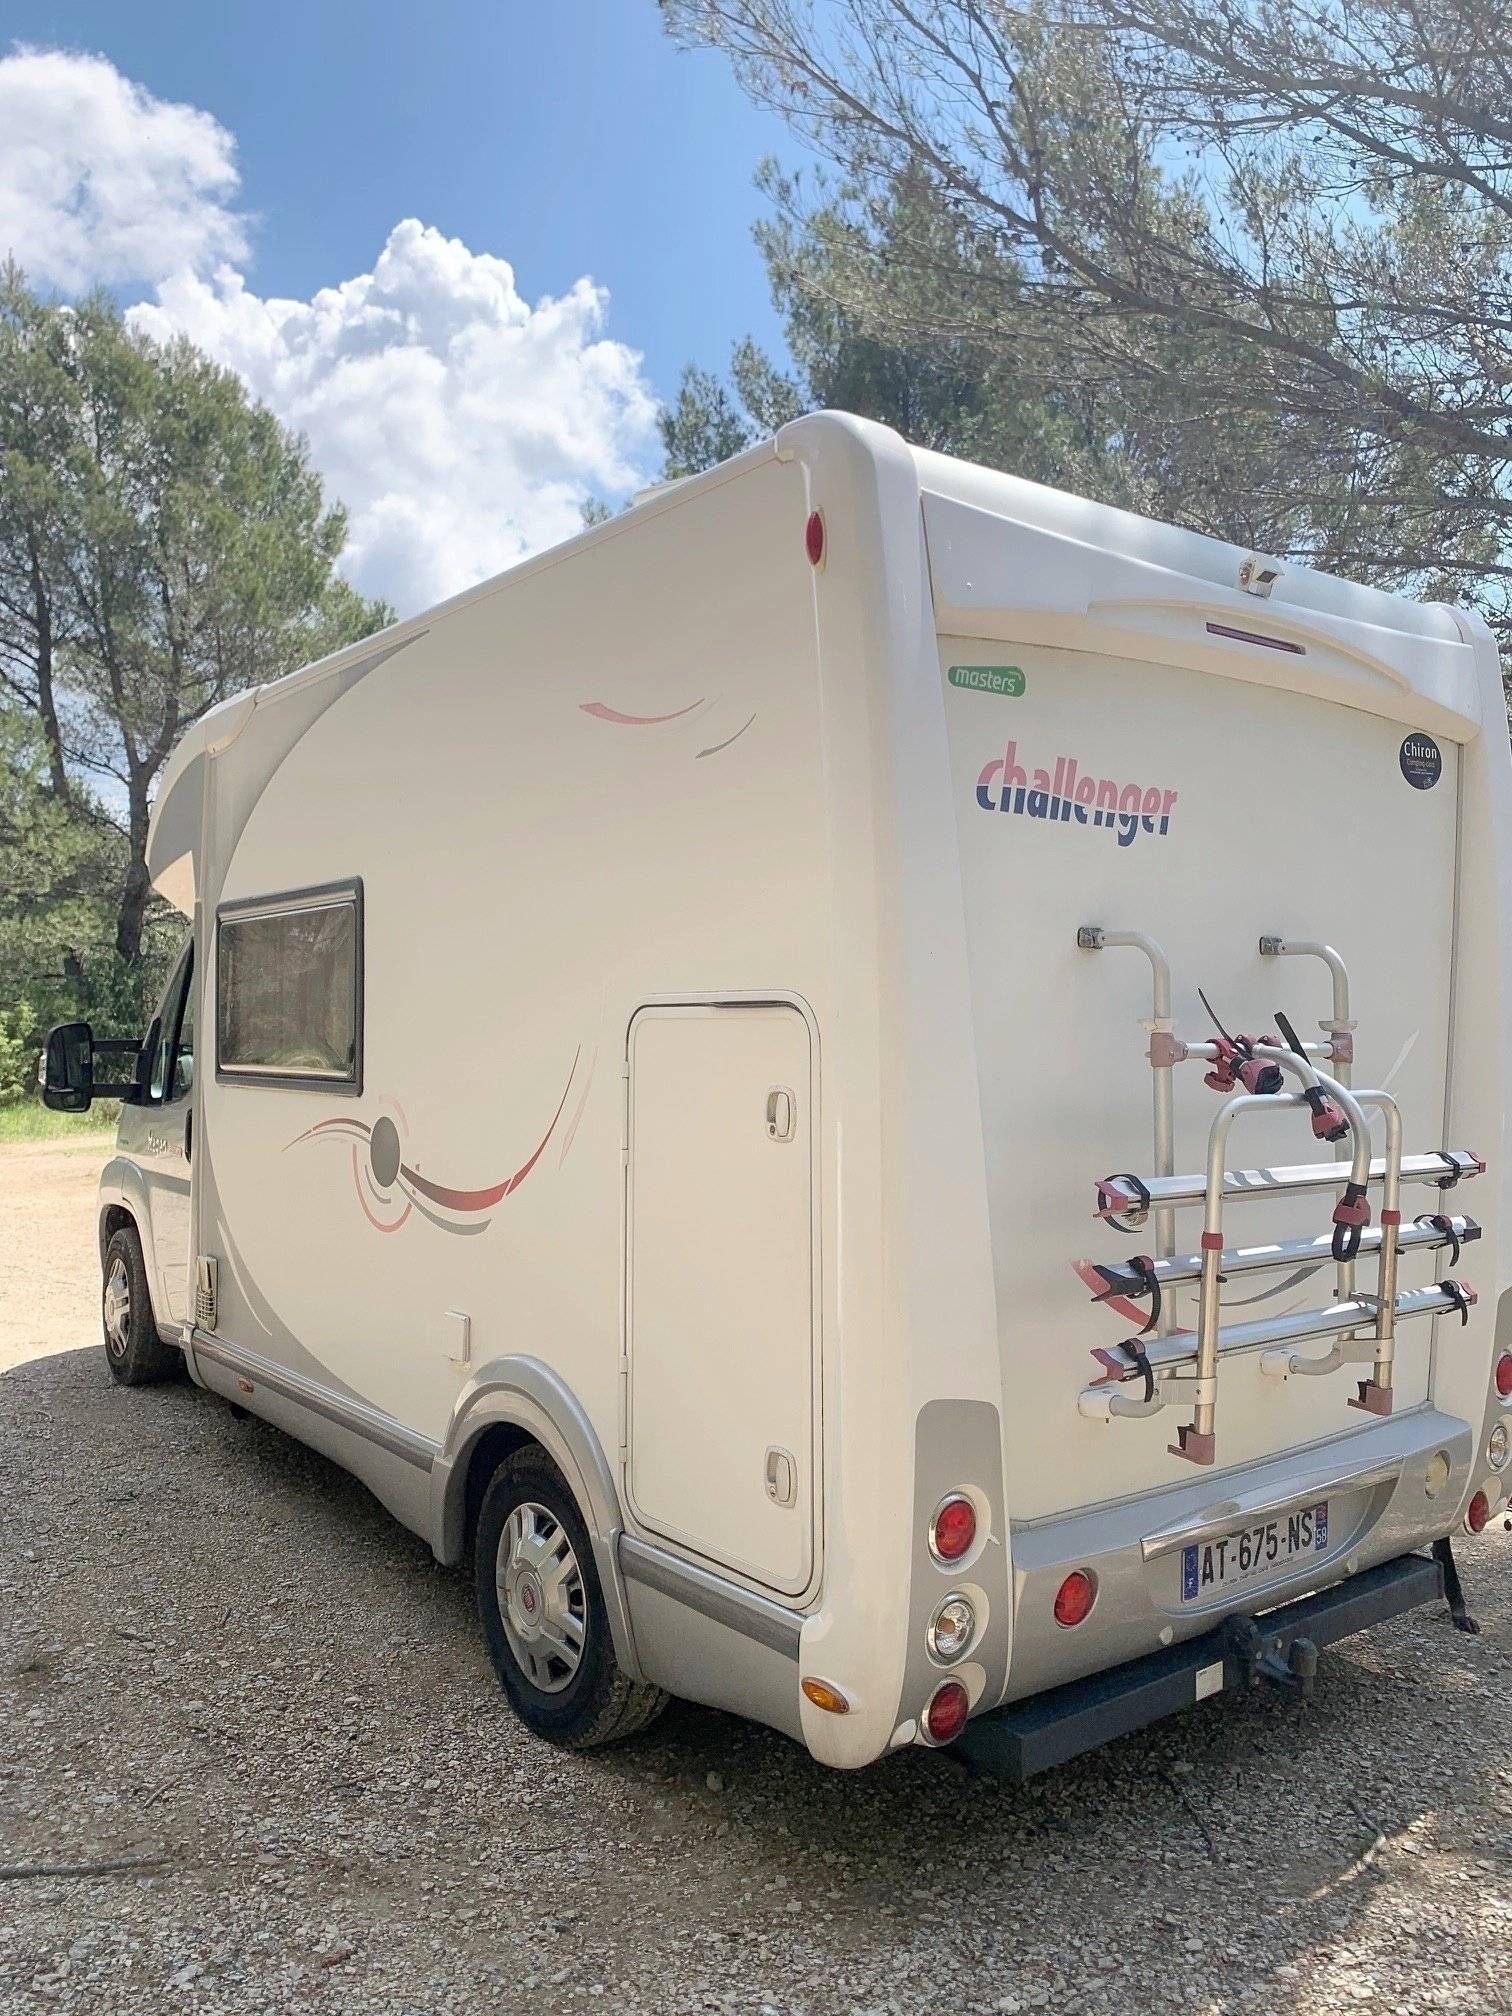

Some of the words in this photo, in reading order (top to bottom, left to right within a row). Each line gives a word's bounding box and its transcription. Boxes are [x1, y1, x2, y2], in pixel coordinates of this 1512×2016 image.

[955, 668, 1016, 692] masters
[1404, 741, 1437, 759] Chiron
[975, 740, 1179, 848] challenger
[1201, 1511, 1313, 1587] AT-675-NS
